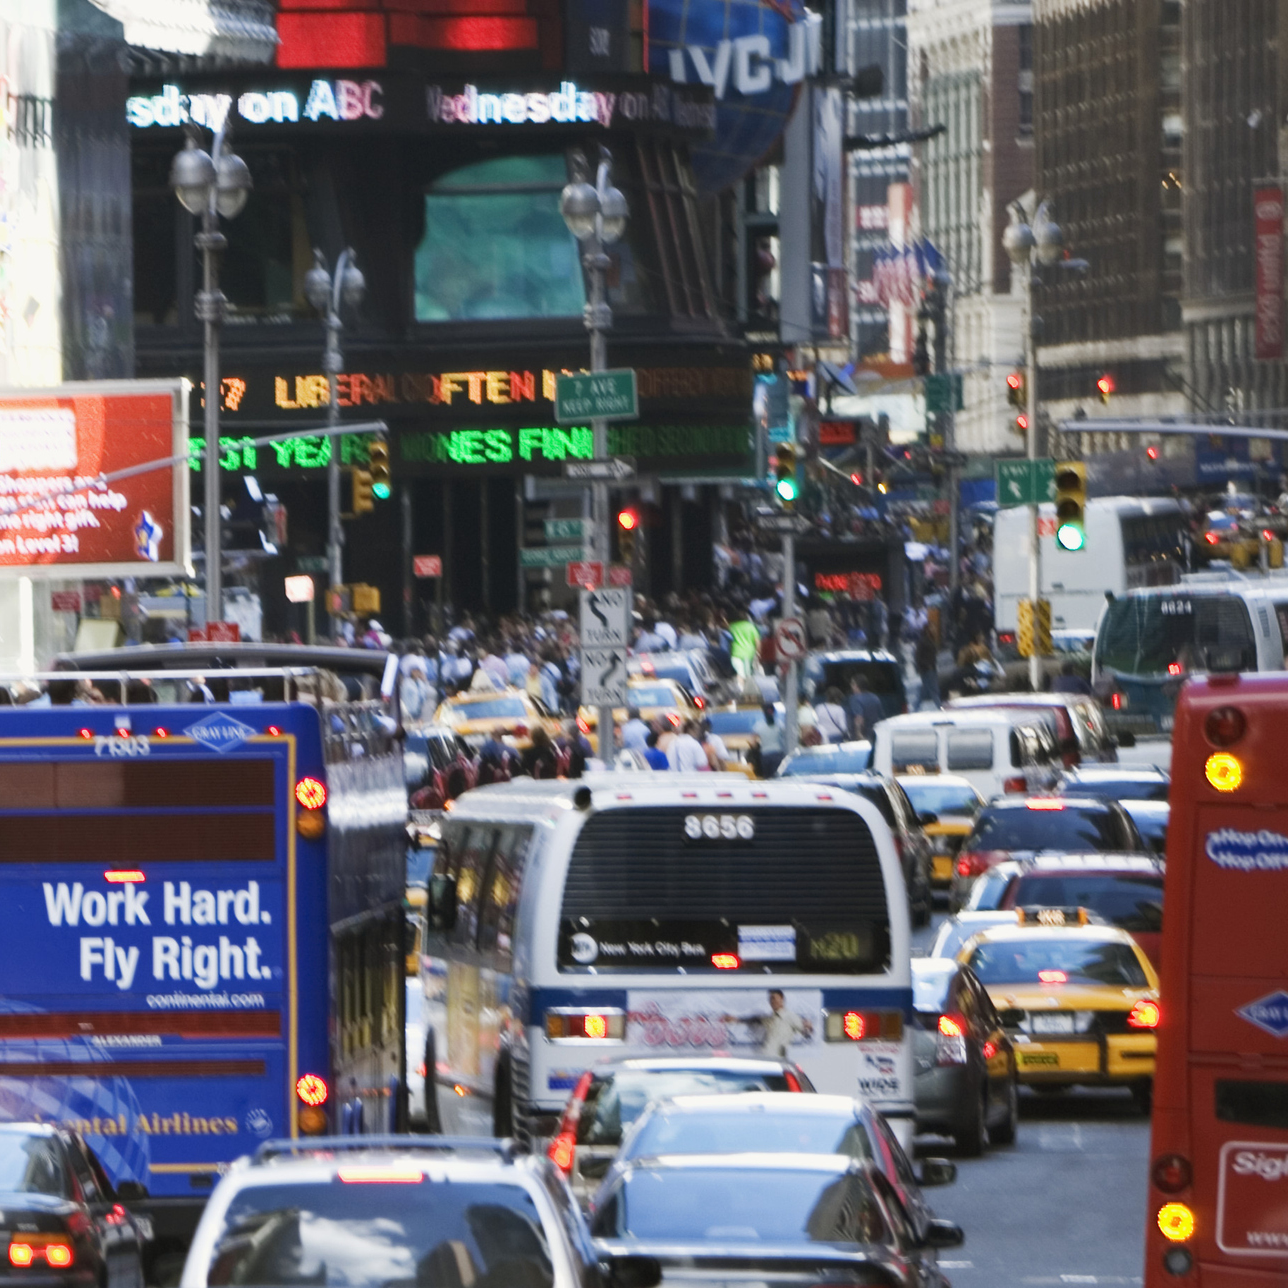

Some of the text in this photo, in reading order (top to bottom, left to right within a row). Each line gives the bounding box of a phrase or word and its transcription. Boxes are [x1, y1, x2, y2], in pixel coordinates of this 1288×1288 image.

[237, 91, 299, 123] on
[303, 79, 384, 122] ABC
[89, 489, 128, 513] help
[683, 814, 755, 841] 8656
[42, 880, 272, 927] Work Hard.
[80, 935, 272, 990] Fly Right.
[599, 940, 706, 960] New York City Bus
[146, 990, 265, 1009] continental.com
[91, 1034, 163, 1048] ALEXANDER
[137, 1111, 239, 1136] Airlines
